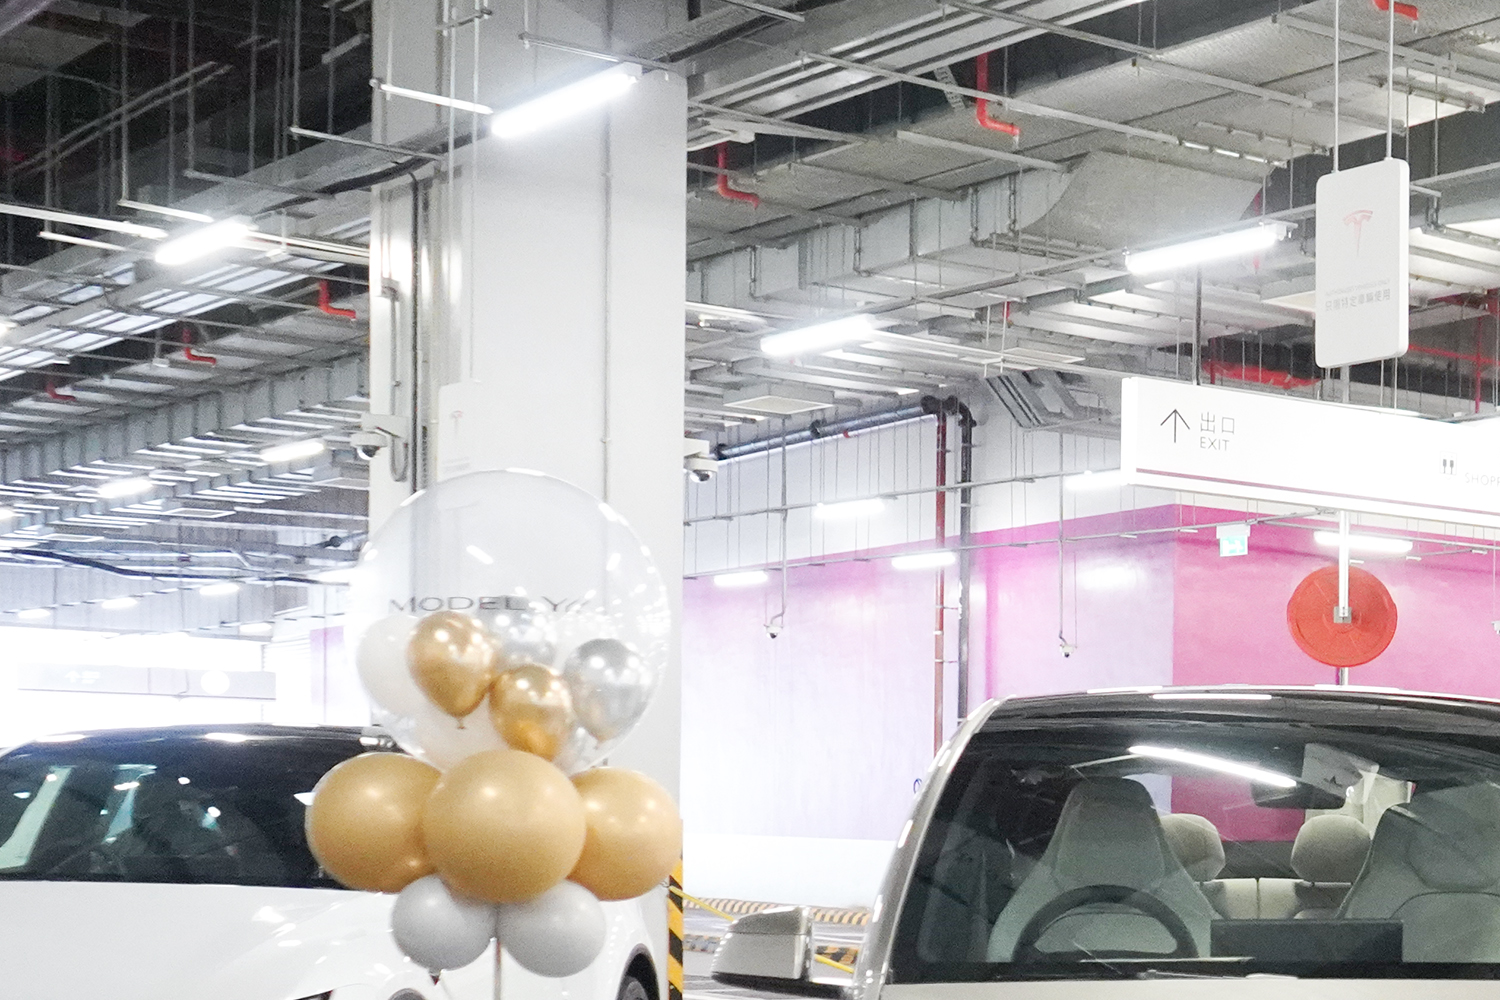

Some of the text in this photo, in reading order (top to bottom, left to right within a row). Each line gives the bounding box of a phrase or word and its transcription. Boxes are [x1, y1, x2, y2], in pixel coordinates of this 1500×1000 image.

[1200, 411, 1235, 434] 出口
[1200, 436, 1230, 451] EXIT
[391, 596, 526, 613] MODEL
